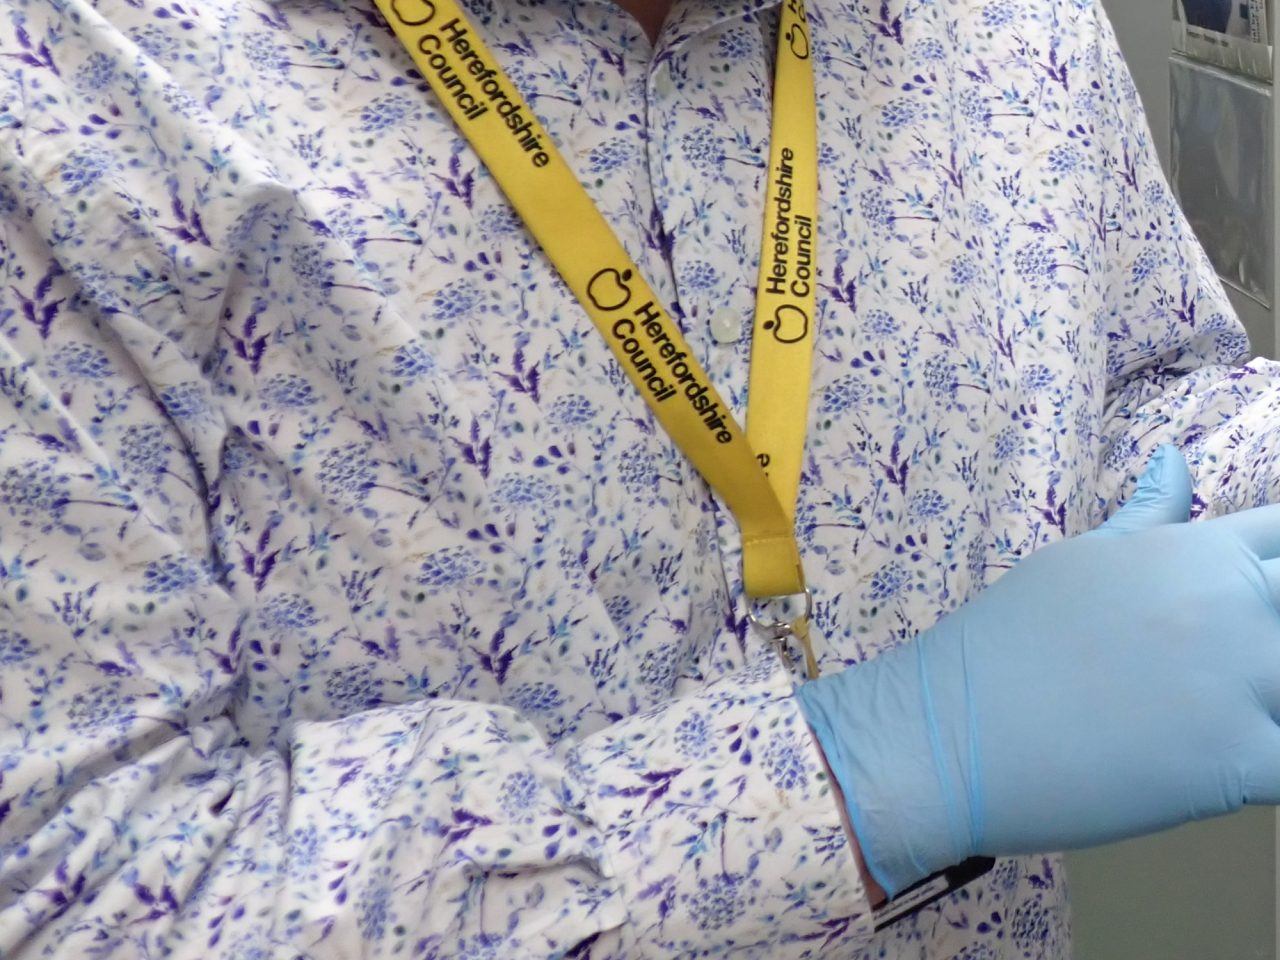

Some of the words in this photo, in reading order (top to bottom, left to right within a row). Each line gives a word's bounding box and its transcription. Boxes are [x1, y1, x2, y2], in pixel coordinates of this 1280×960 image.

[417, 34, 489, 121] Council
[439, 17, 550, 168] Herefordshire
[765, 146, 794, 296] Herefordshire
[790, 215, 812, 299] Council
[612, 318, 677, 402] Council
[633, 301, 733, 445] Herefordshire
